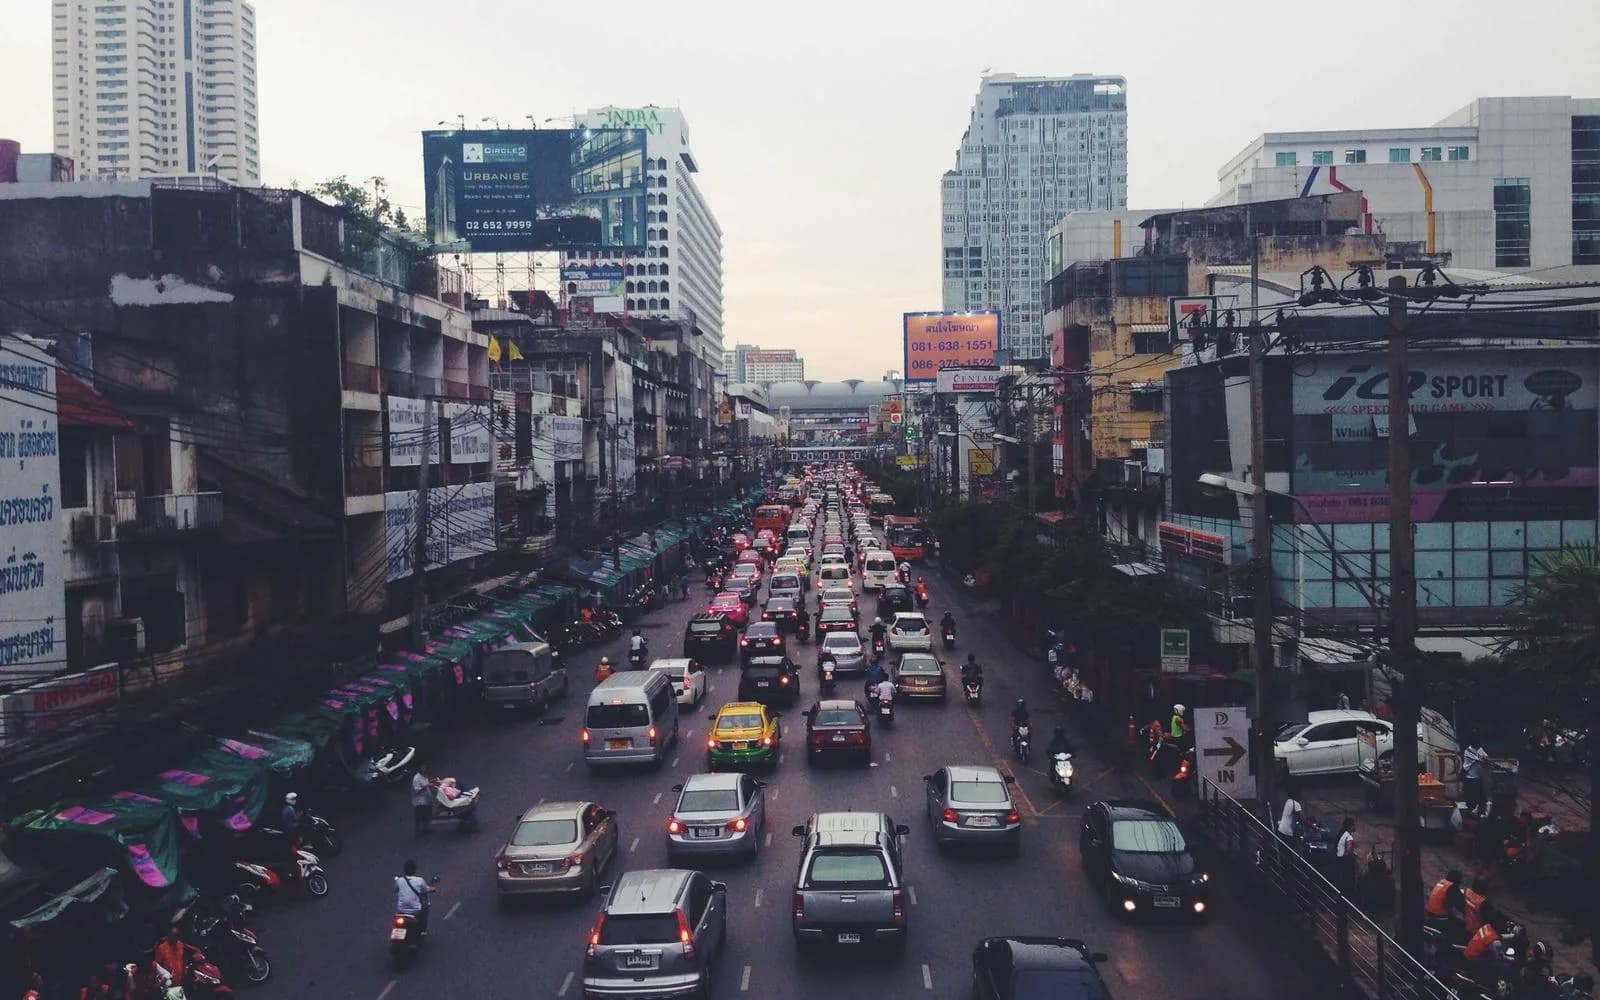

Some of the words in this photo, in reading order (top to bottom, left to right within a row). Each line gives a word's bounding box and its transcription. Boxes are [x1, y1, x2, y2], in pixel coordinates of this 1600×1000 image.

[608, 110, 658, 122] INDRA
[466, 221, 479, 230] 02
[482, 221, 503, 230] 652
[505, 221, 532, 230] 9999
[1431, 374, 1508, 399] SPORT
[1217, 769, 1235, 783] IN
